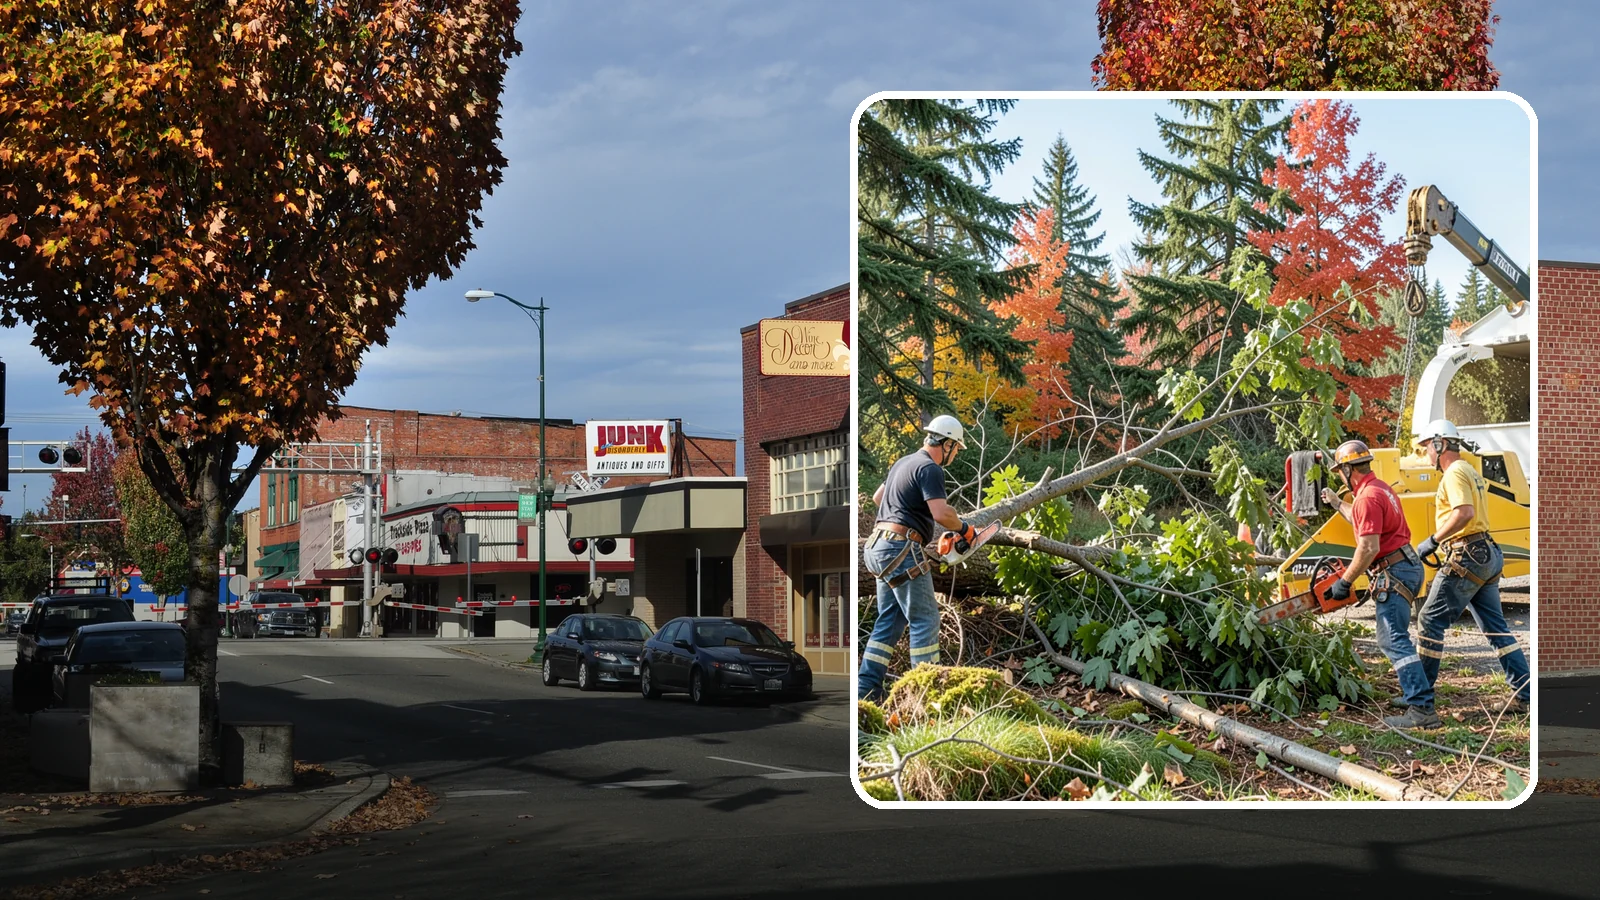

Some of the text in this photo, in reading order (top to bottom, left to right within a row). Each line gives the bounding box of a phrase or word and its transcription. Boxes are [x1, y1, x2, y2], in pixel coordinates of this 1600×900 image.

[595, 425, 664, 457] JUNK
[607, 446, 646, 454] DISORDERLY
[596, 460, 666, 470] ANTIQUES AND GIFTS
[390, 520, 429, 539] Trackside Pizza
